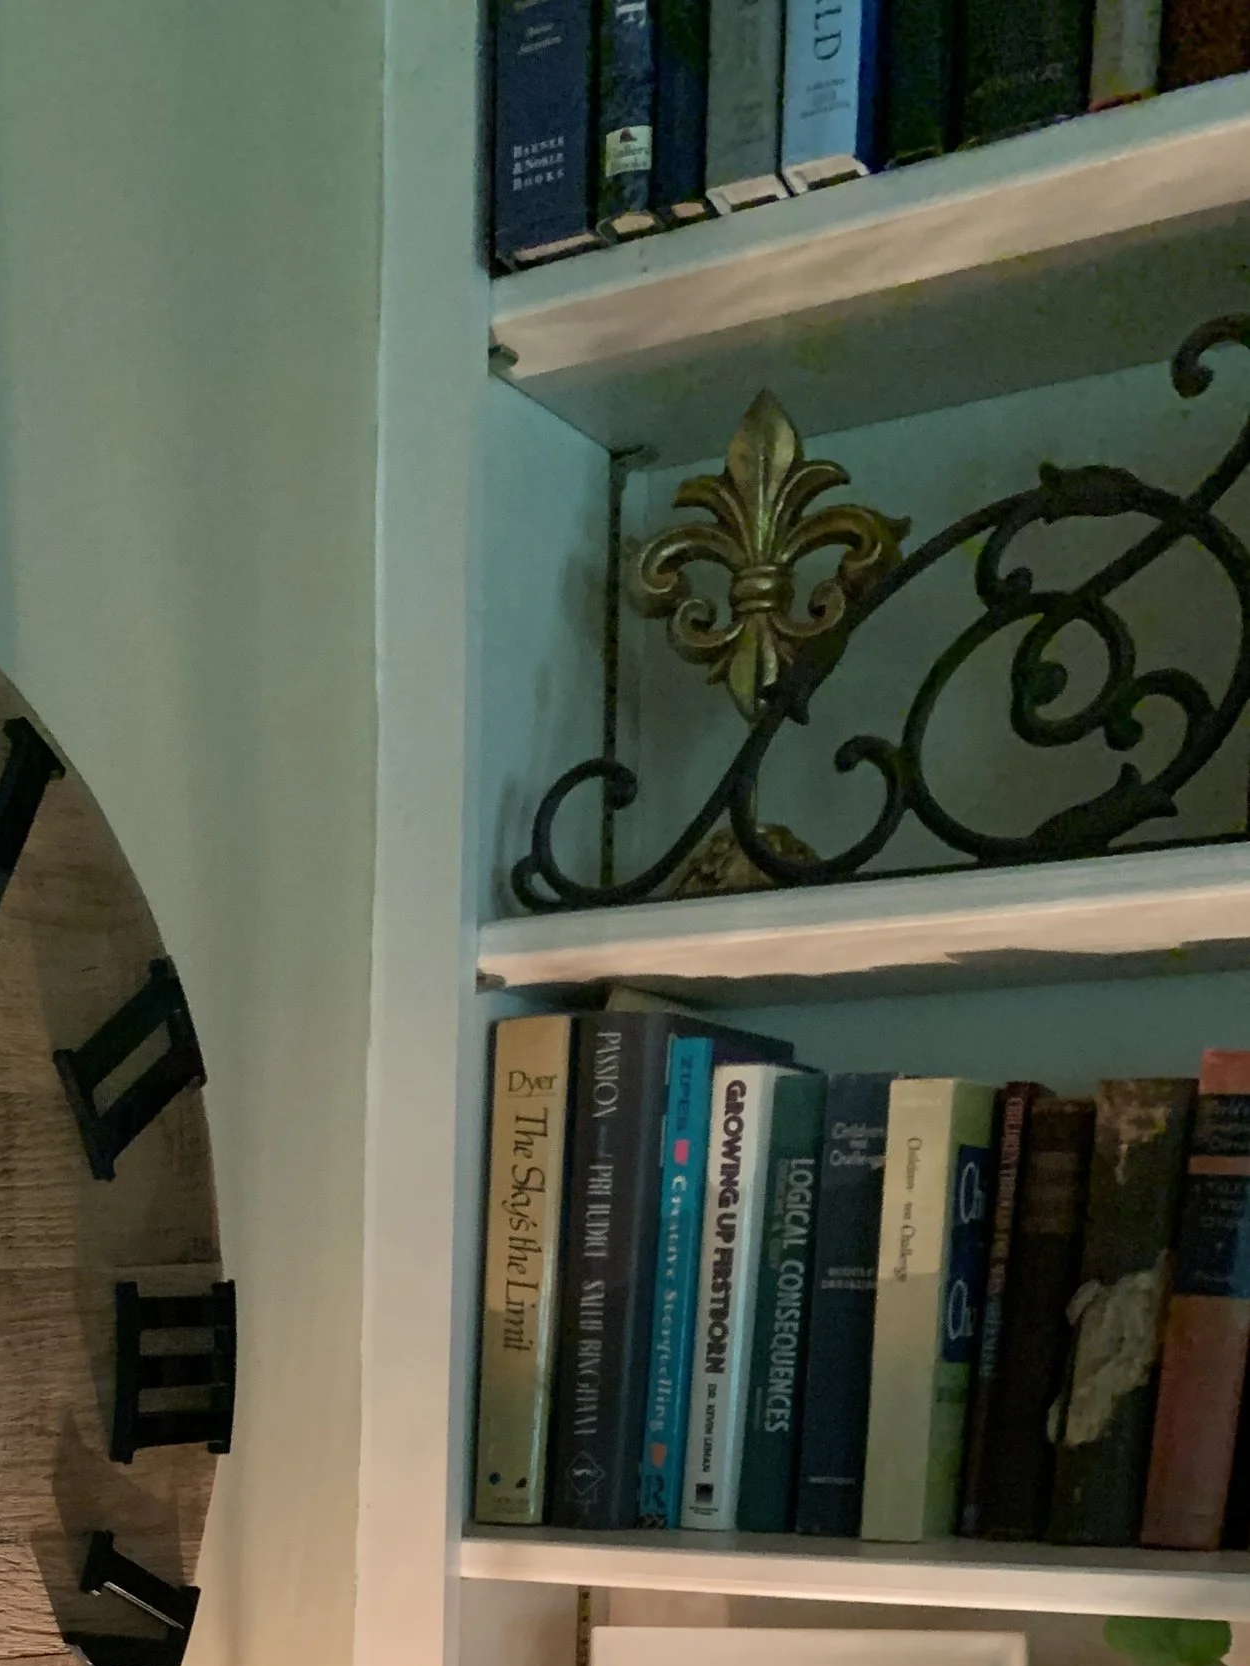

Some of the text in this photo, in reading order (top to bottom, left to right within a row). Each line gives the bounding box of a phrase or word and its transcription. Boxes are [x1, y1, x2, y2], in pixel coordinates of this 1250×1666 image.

[54, 958, 207, 1179] II
[507, 1070, 558, 1098] Dyer
[592, 1031, 622, 1118] PASSION
[501, 1107, 548, 1351] The Sky's the Limit
[705, 1079, 747, 1374] GROWING UP FIRSTBORN
[782, 1158, 816, 1250] LOGICAL
[113, 1279, 236, 1464] III
[764, 1257, 806, 1434] CONSEQUENCES
